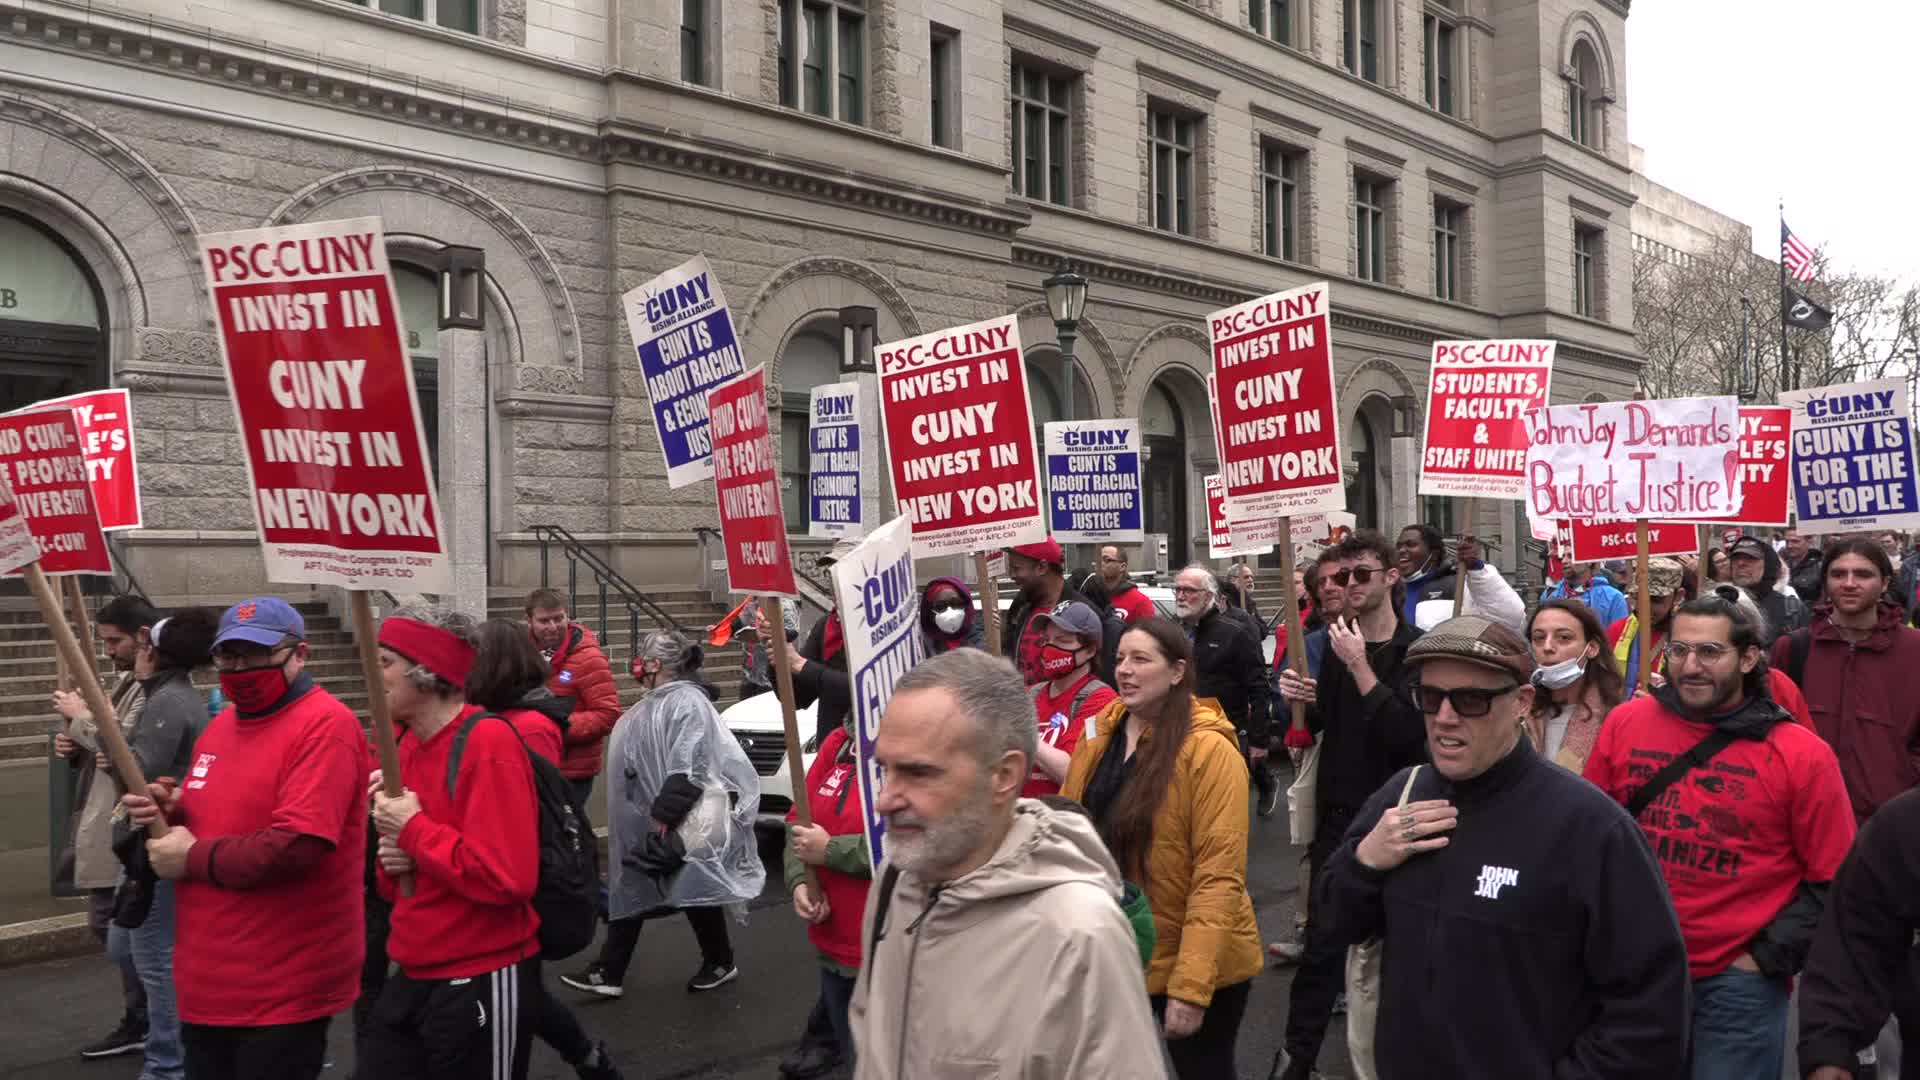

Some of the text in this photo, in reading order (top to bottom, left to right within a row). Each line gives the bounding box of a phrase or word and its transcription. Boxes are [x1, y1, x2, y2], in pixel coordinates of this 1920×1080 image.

[208, 233, 375, 281] PSC-CUNY
[230, 288, 381, 332] INVEST IN
[645, 271, 710, 324] CUNY
[677, 298, 716, 322] ALLIANCE
[1211, 291, 1322, 340] PSC-CUNY
[657, 320, 713, 366] CUNY IS
[880, 324, 1011, 374] PSC-CUNY
[1220, 323, 1316, 369] INVEST IN
[1435, 344, 1550, 363] PSC-CUNY
[269, 359, 367, 410] CUNY
[648, 344, 741, 404] ABOUT RACIAL
[890, 357, 1010, 403] INVEST IN
[1234, 367, 1304, 411] CUNY
[1433, 372, 1545, 400] STUDENTS,
[663, 391, 709, 432] & ECON
[816, 395, 854, 417] CUNY
[1443, 397, 1531, 420] FACULTY
[1806, 390, 1895, 418] CUNY
[1811, 409, 1895, 425] RISING ALLIANCE
[82, 430, 126, 454] E'S
[837, 426, 848, 448] IS
[911, 401, 998, 446] CUNY
[1063, 429, 1130, 446] CUNY
[1229, 408, 1321, 447] INVEST IN
[1473, 422, 1489, 445] &
[1524, 403, 1731, 460] John Jay Demands
[1794, 420, 1904, 457] CUNY IS
[260, 428, 404, 467] INVEST IN
[830, 451, 860, 472] RACIAL
[902, 442, 1019, 482] INVEST IN
[1068, 454, 1117, 473] CUNY IS
[1425, 446, 1472, 469] STAFF
[1051, 473, 1138, 492] ABOUT RACIAL
[1226, 446, 1337, 489] NEW YORK
[1530, 450, 1739, 519] Budget Justice!
[1798, 451, 1908, 487] FOR THE
[258, 488, 436, 538] NEW YORK
[900, 480, 1036, 524] NEW YORK
[1057, 492, 1134, 511] & ECONOMIC
[1807, 483, 1905, 516] PEOPLE
[1071, 512, 1121, 529] JUSTICE
[1474, 879, 1502, 900] JAY
[1476, 864, 1520, 887] JOHN
